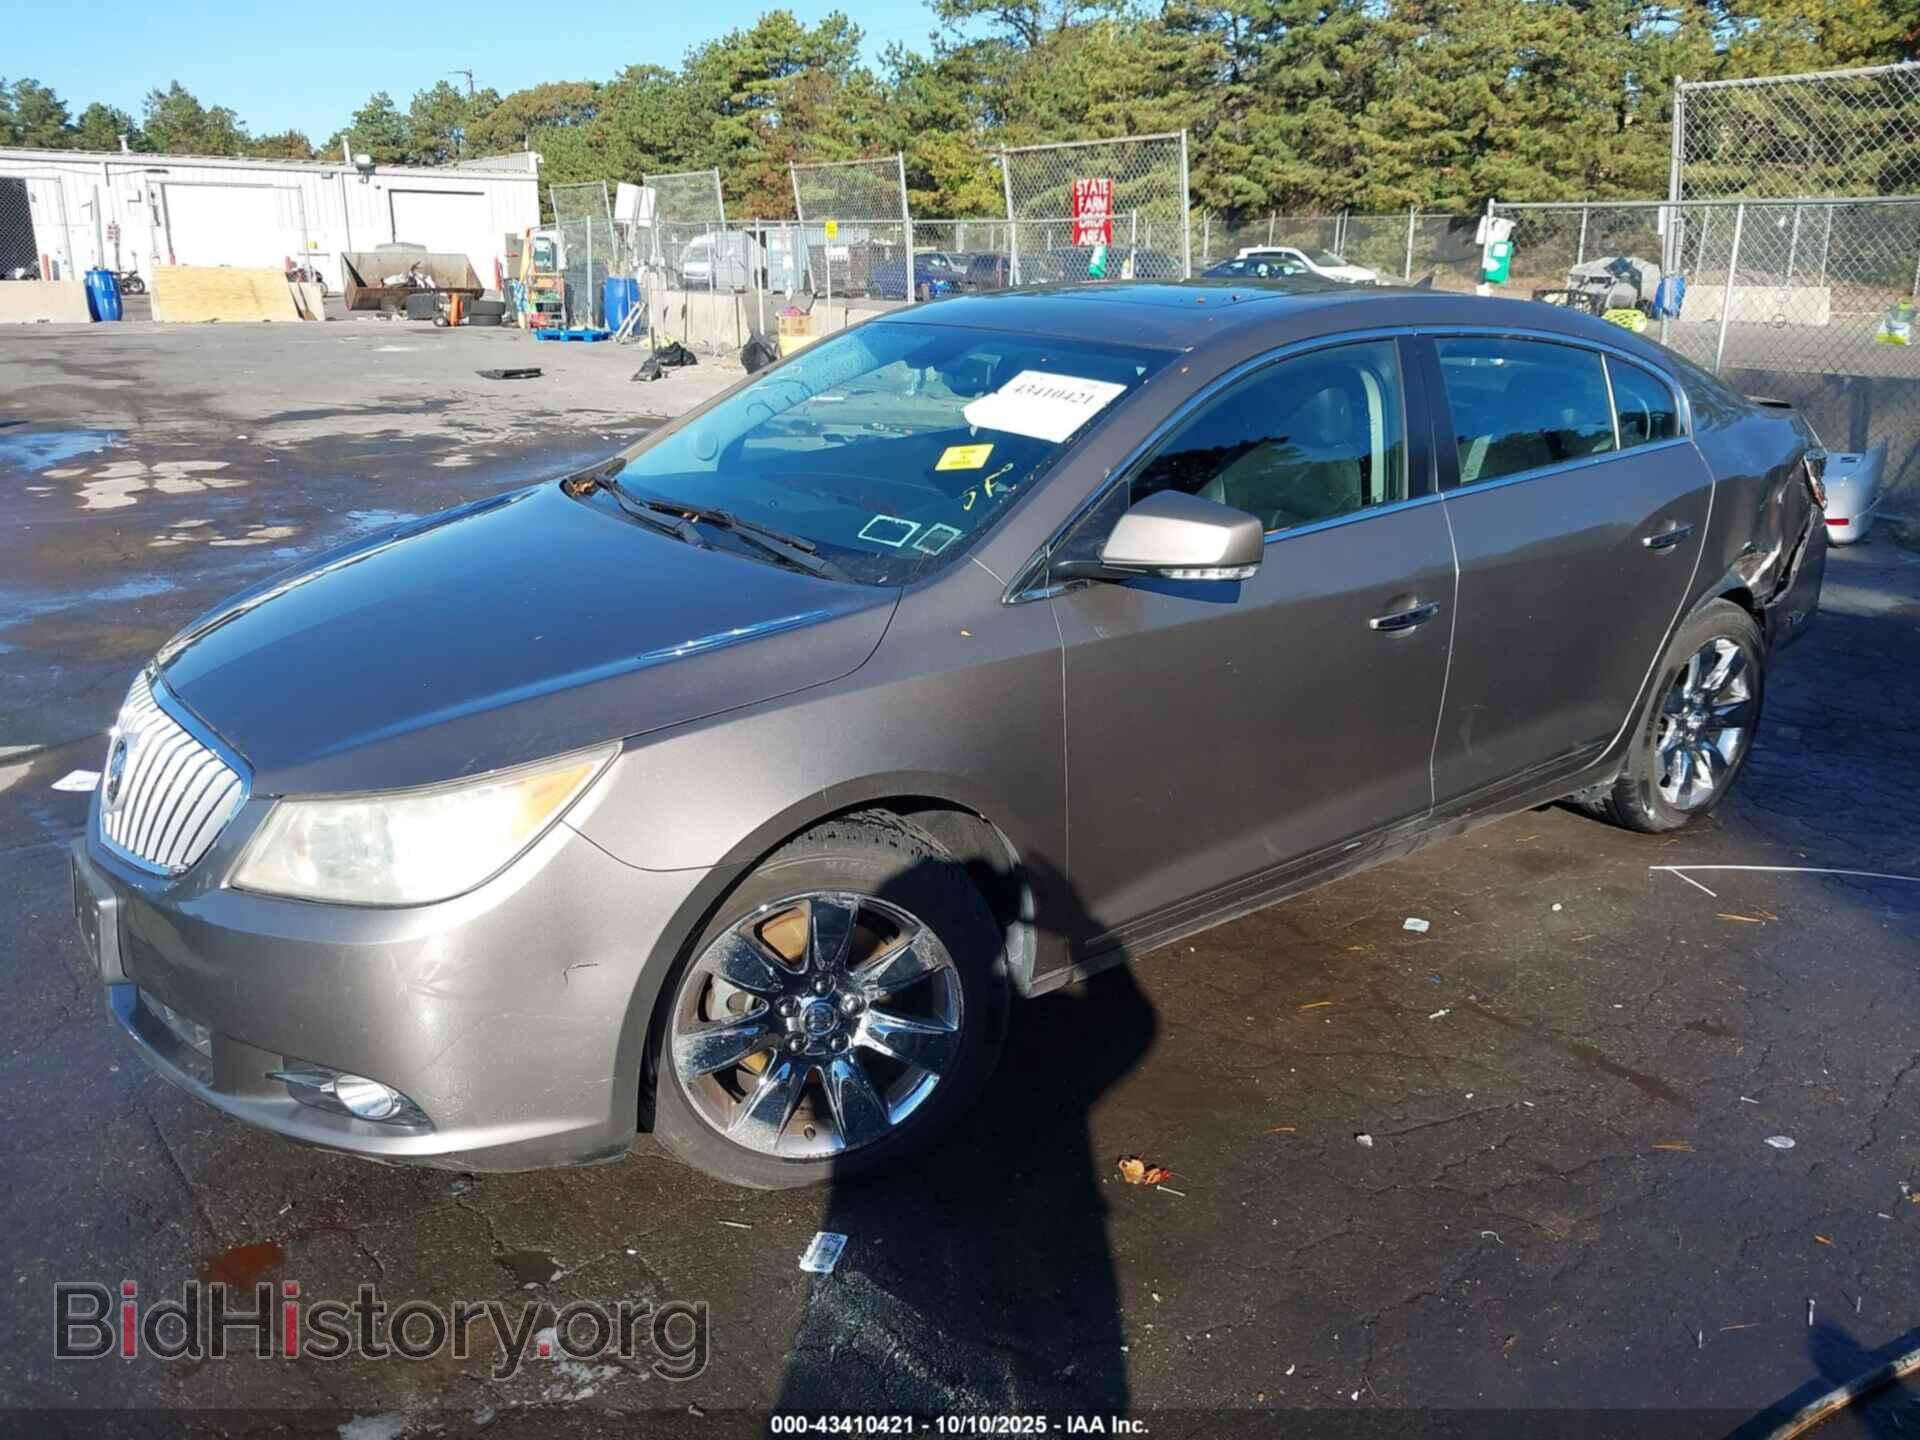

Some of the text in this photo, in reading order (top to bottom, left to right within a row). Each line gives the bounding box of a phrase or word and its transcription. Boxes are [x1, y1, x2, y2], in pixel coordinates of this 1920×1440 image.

[1076, 178, 1109, 195] STATE
[1078, 196, 1108, 212] FARM
[1078, 228, 1108, 245] AREA
